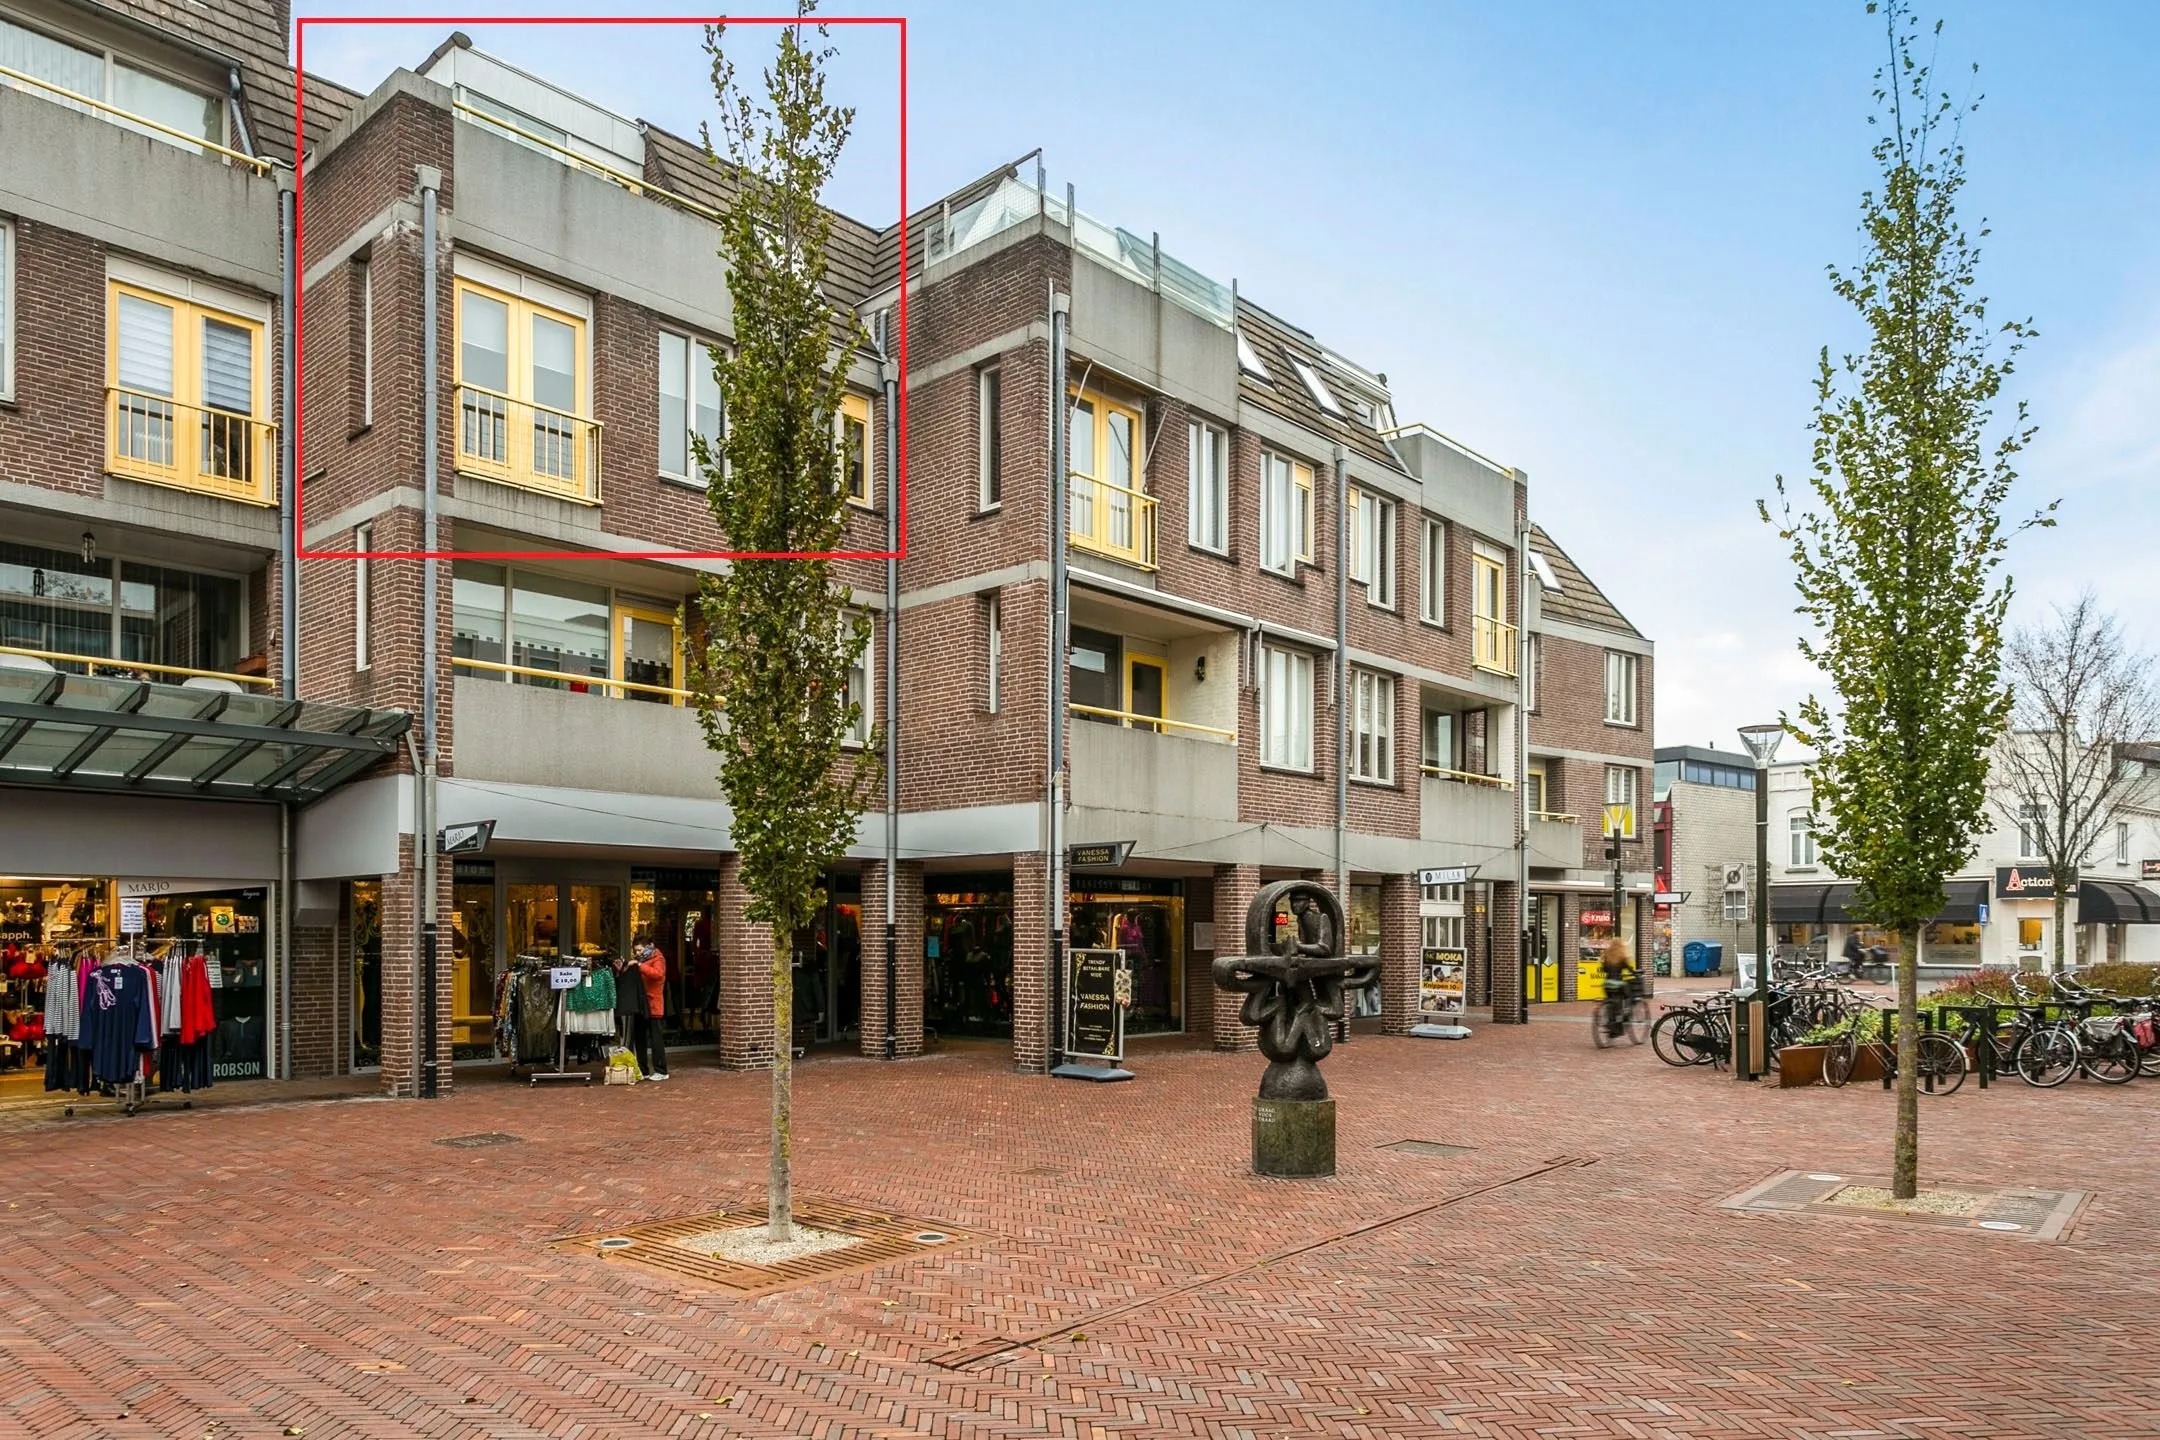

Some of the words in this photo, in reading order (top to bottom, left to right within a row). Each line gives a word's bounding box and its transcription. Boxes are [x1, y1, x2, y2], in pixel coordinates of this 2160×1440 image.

[1077, 848, 1110, 856] VANESSA
[128, 881, 170, 893] MARJO
[0, 930, 33, 942] apph.
[1435, 952, 1463, 961] MOKA
[1080, 993, 1110, 1001] VANESSA
[1080, 1002, 1110, 1010] FASHION
[212, 1061, 260, 1077] ROBSON
